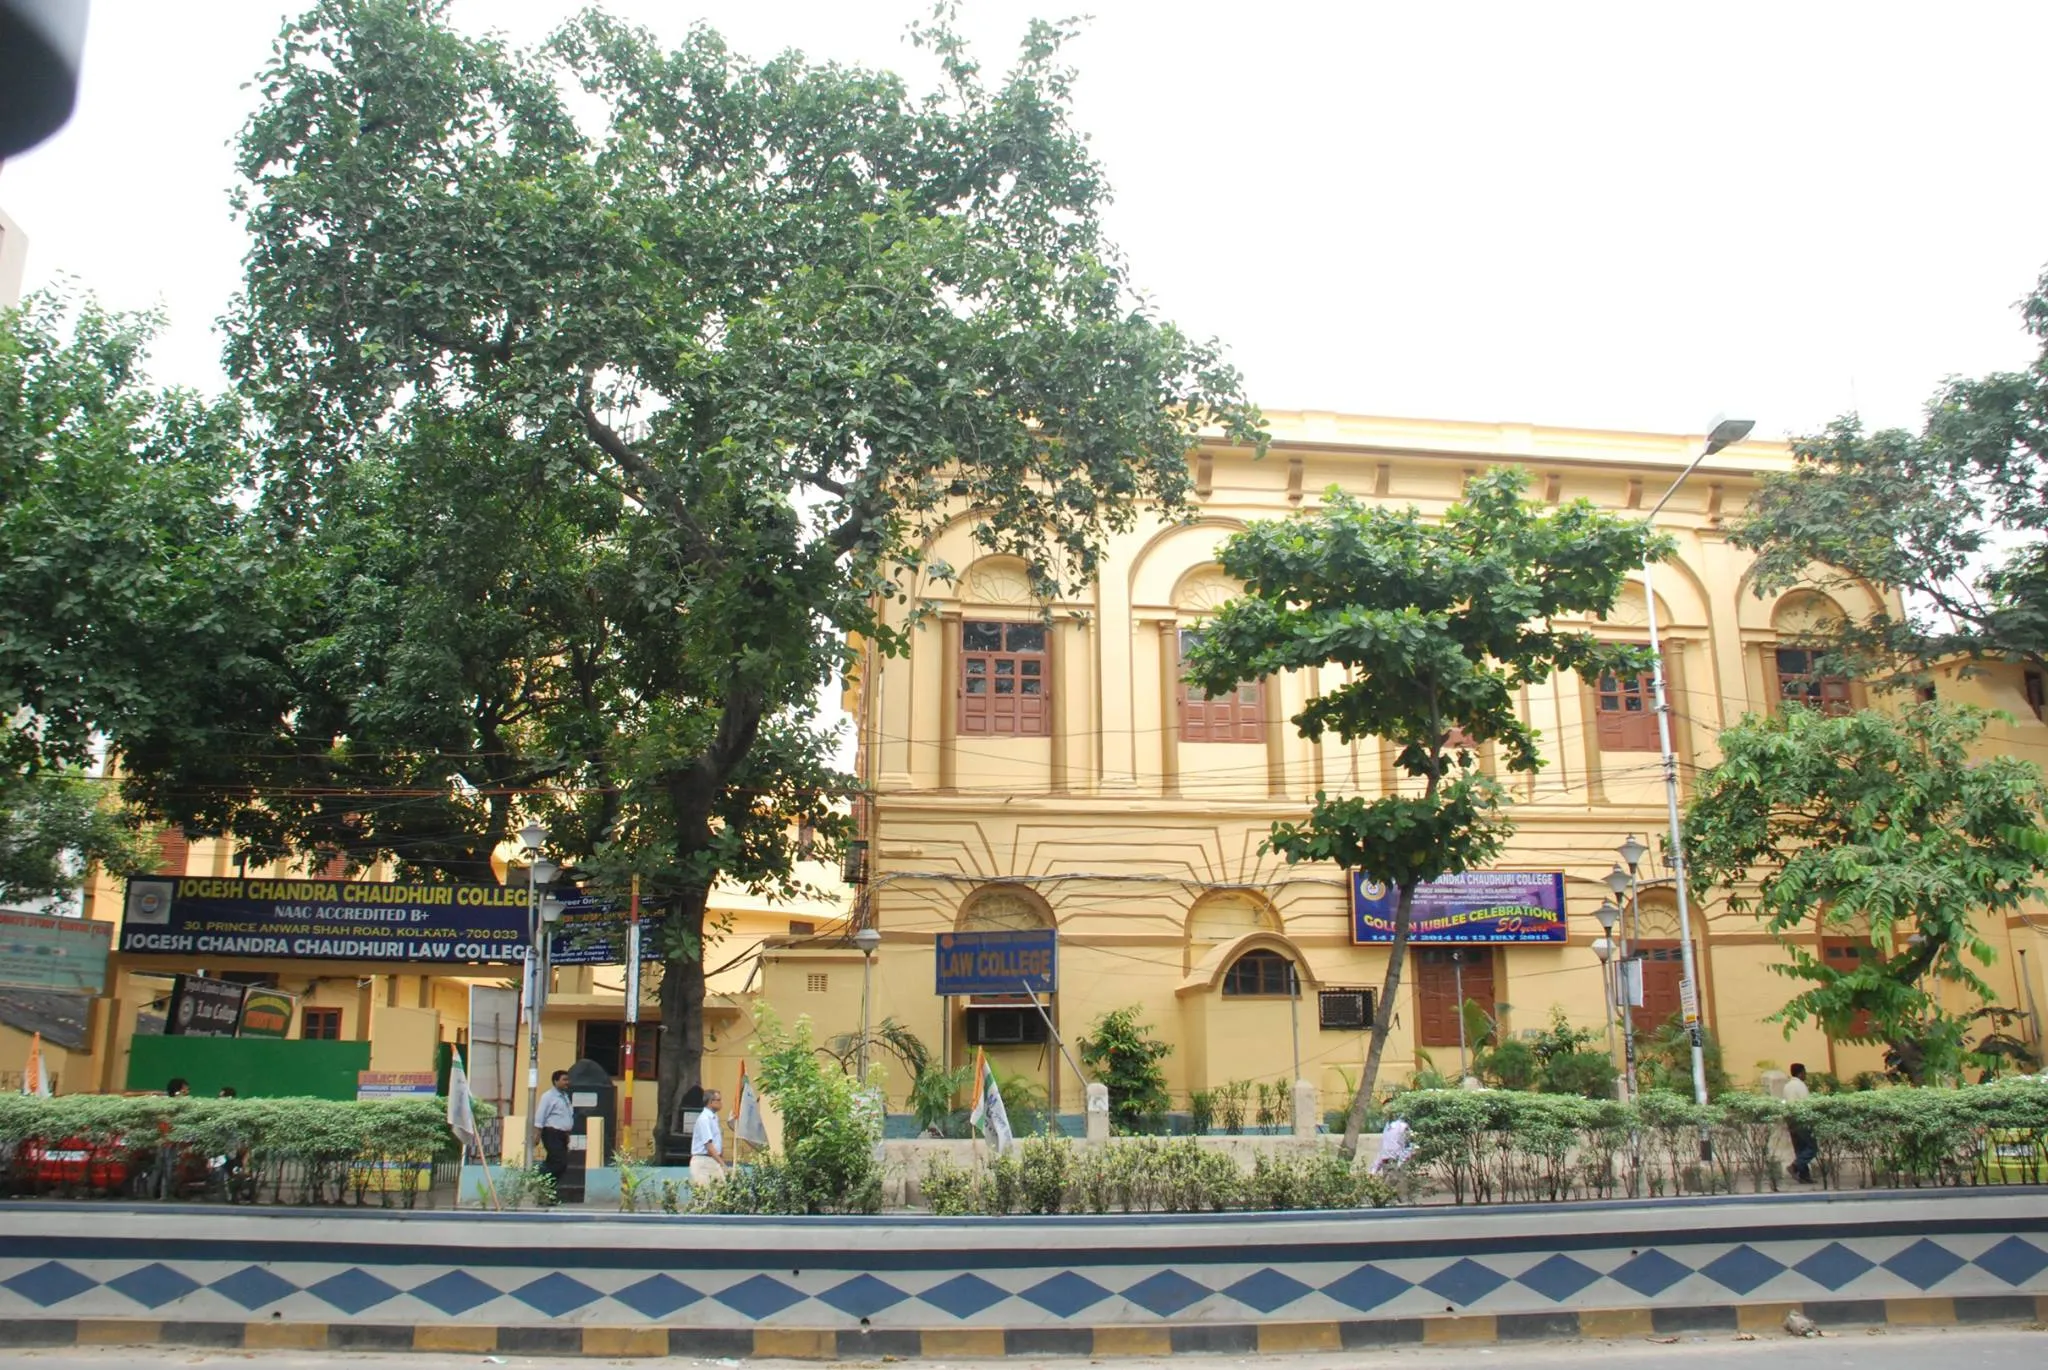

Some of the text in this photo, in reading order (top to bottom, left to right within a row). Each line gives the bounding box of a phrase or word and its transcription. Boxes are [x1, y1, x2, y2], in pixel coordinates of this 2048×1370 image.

[1467, 873, 1515, 885] CHAUDHURI
[1517, 873, 1553, 885] COLLEGE
[177, 879, 244, 899] JOGESH
[248, 881, 338, 902] CHANDRA
[343, 885, 453, 905] CHAUDHURI
[457, 887, 539, 907] COLLEGE
[274, 905, 430, 922] NAAC ACCREDITED B+
[1420, 913, 1467, 932] JUBILEE
[1468, 905, 1558, 923] CELEBRATIONS
[1495, 916, 1522, 933] 50
[206, 922, 257, 933] PRINCE
[259, 923, 311, 934] ANWAR
[312, 924, 350, 935] SHAH
[352, 926, 394, 938] ROAD,
[396, 927, 457, 938] KOLKATA
[466, 929, 491, 939] 700
[492, 930, 518, 940] 033
[125, 933, 533, 960] JOGESH CHANDRA CHAUDHURI LAW COLLEG
[941, 949, 1051, 977] LAW COLLEGE
